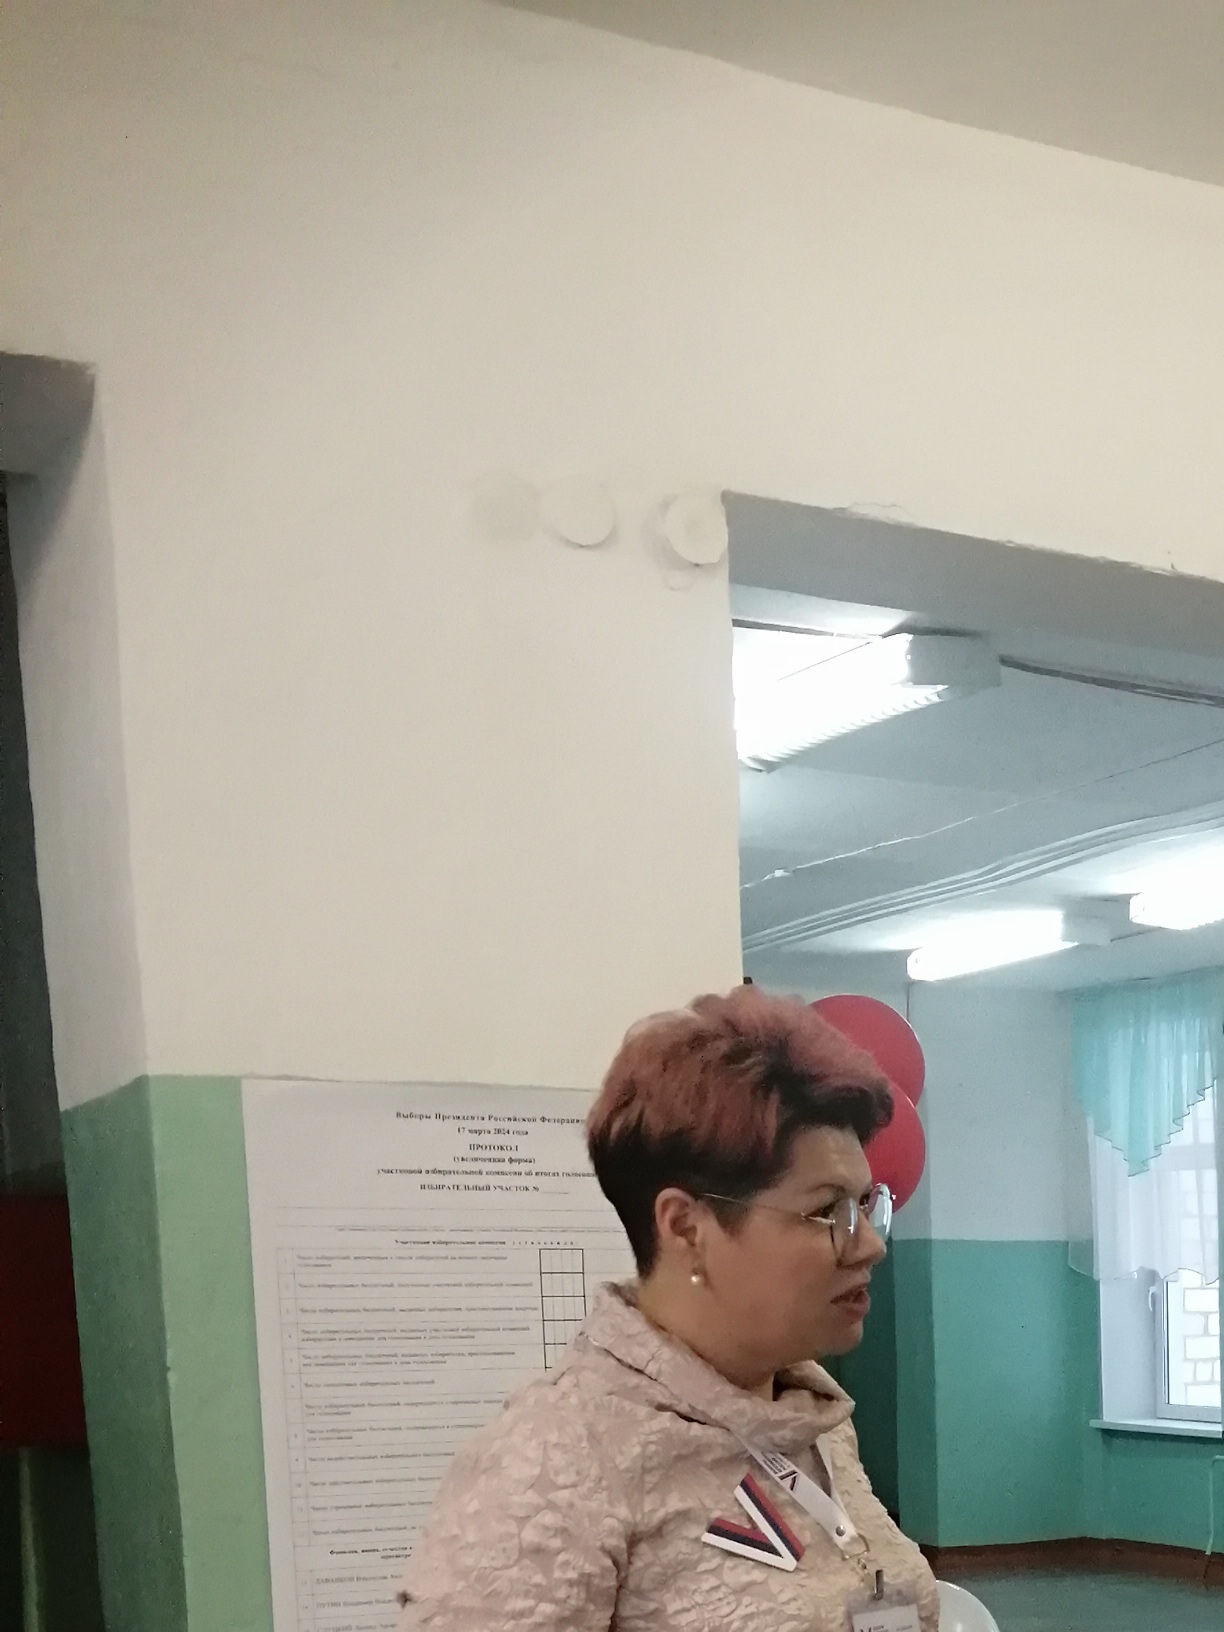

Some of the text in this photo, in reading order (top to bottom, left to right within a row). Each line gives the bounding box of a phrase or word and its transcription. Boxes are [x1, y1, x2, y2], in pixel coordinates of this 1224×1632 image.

[395, 1111, 431, 1121] Выборы
[434, 1113, 485, 1122] Президента
[488, 1114, 537, 1123] Российской
[469, 1143, 519, 1151] ПРОТОКОЛ
[420, 1183, 491, 1191] ИЗБИРАТЕЛЬНЫЙ
